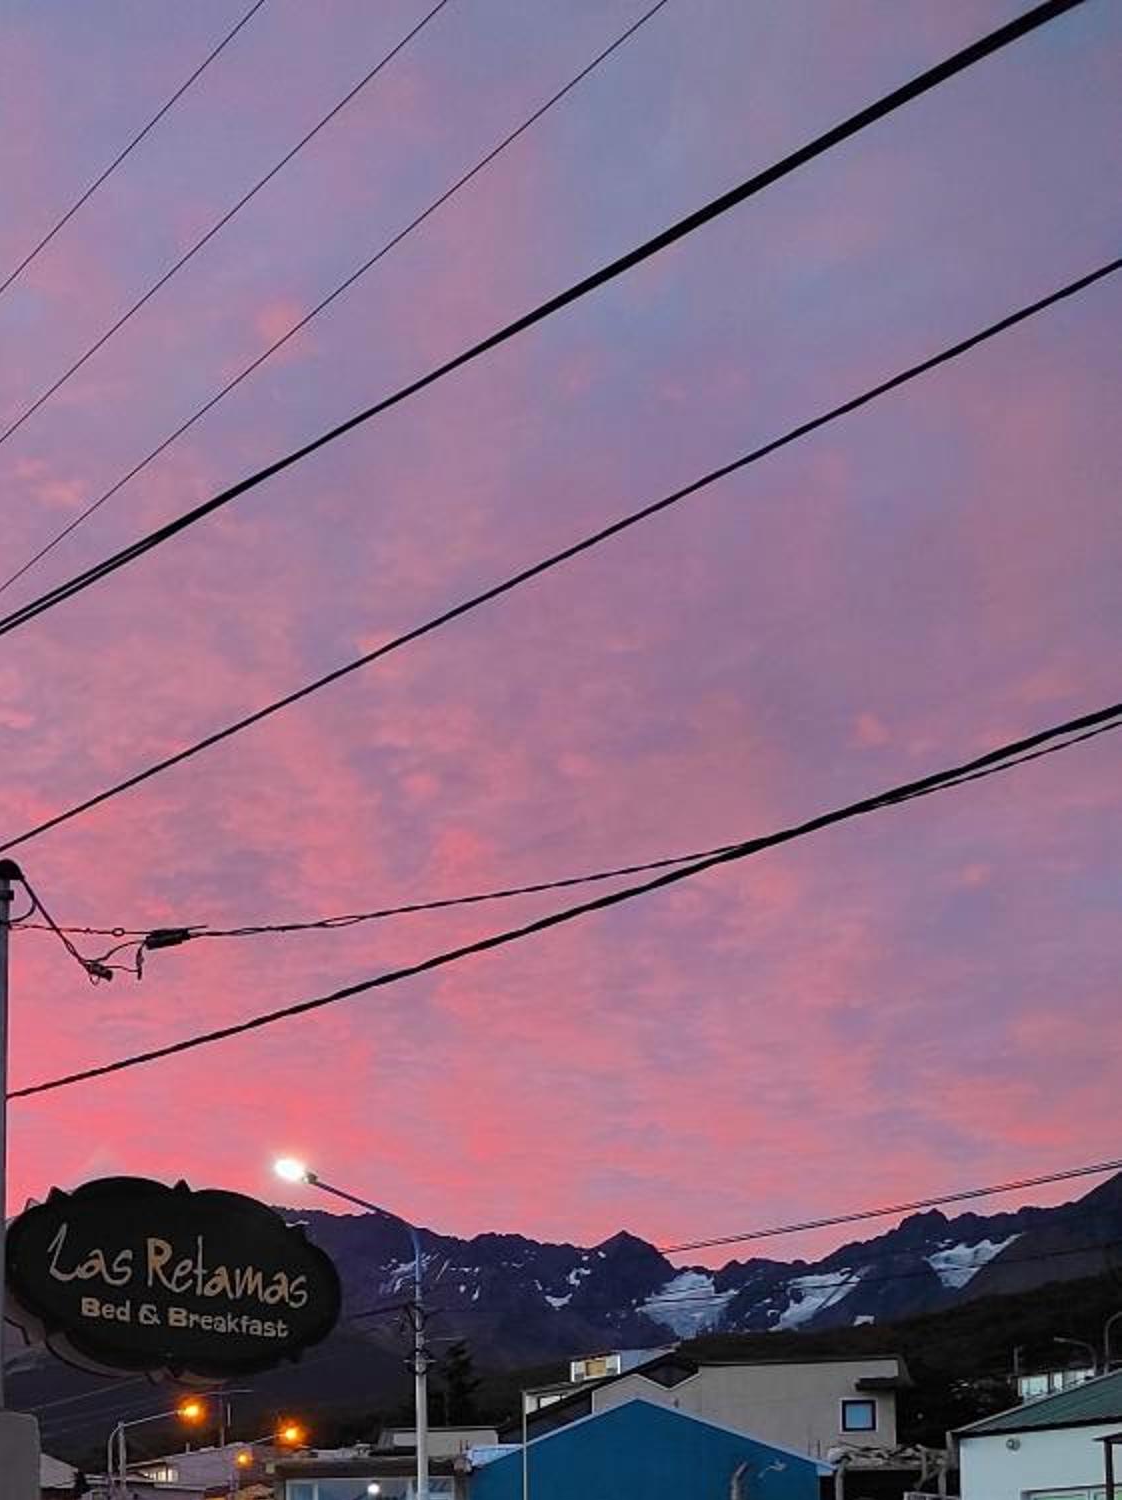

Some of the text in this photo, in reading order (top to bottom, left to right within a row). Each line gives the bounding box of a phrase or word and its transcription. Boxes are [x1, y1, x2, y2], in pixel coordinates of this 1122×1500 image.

[47, 1223, 309, 1309] Las Retamas
[81, 1297, 289, 1338] Bed & Breakfast
